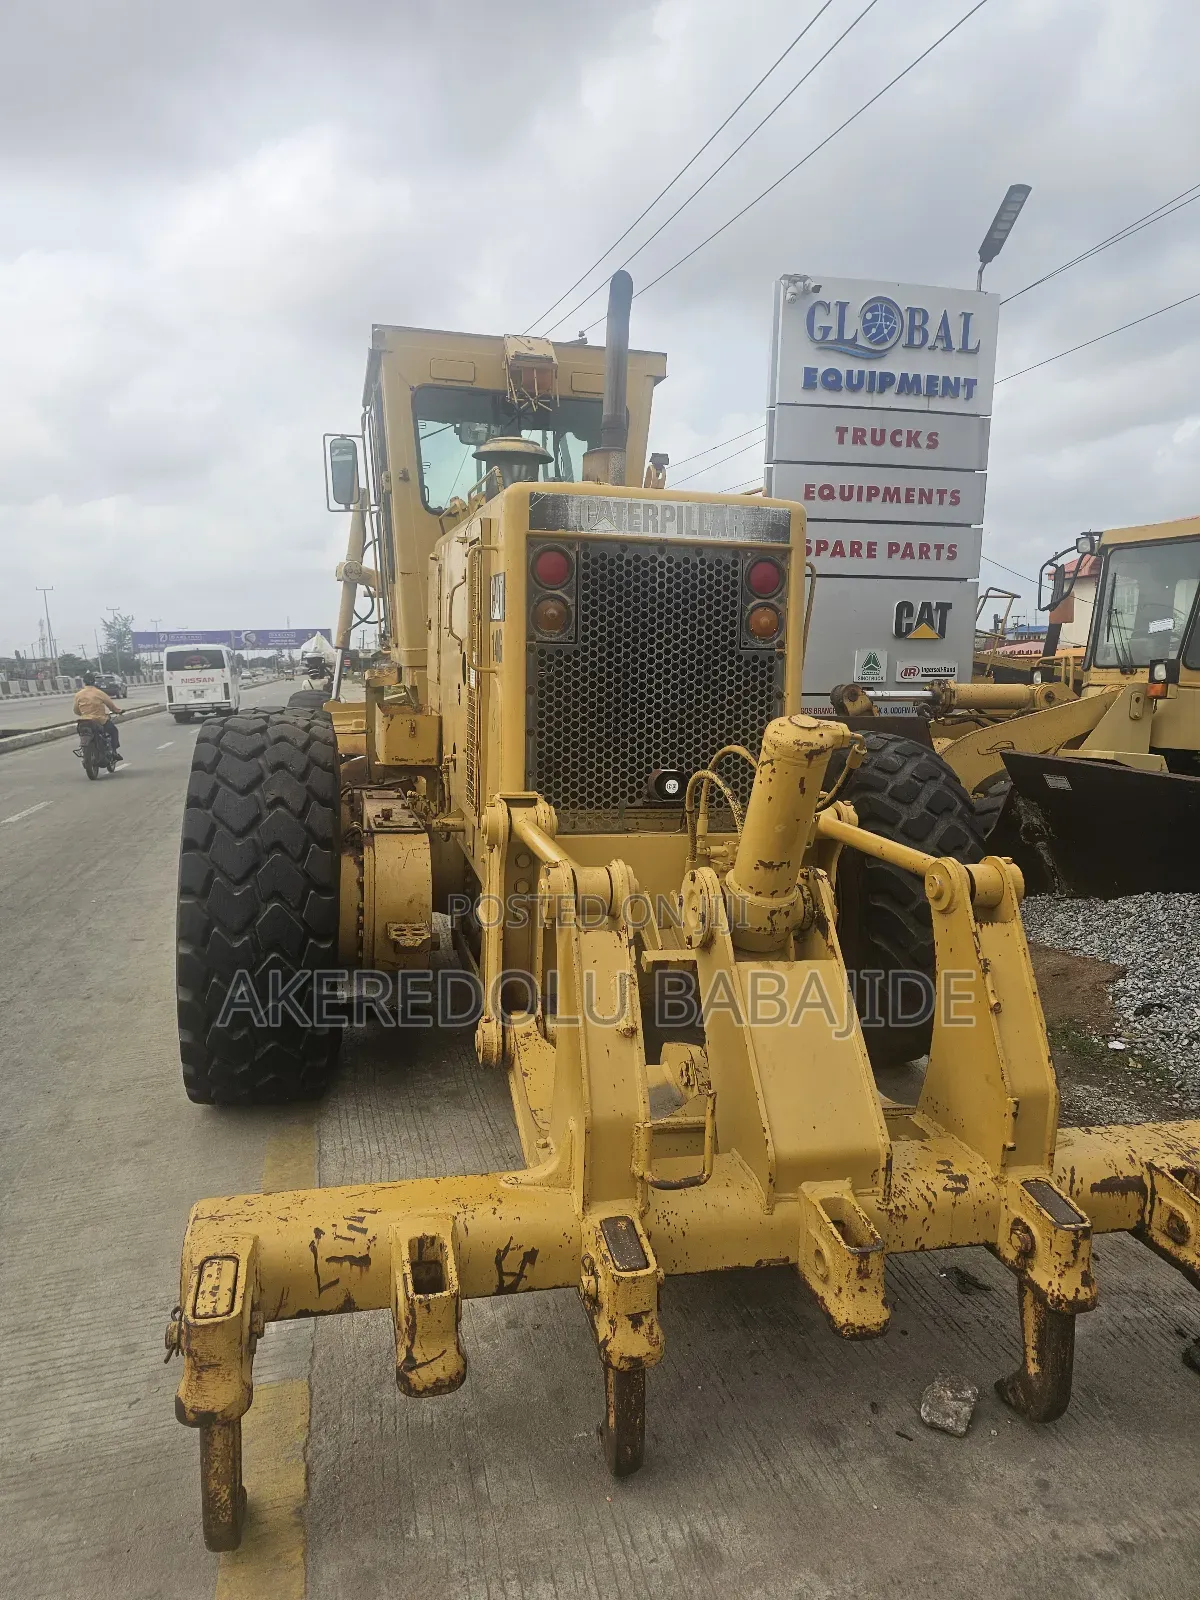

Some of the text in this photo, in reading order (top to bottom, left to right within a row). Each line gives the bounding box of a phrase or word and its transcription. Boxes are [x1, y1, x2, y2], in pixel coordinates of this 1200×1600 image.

[806, 296, 980, 354] GLOBAL
[802, 366, 977, 400] EQUIPMENT
[835, 426, 940, 450] TRUCKS
[804, 483, 961, 506] EQUIPMENTS
[581, 500, 745, 538] CATERPILLAR
[887, 542, 958, 561] PARTS
[893, 600, 952, 640] CAT
